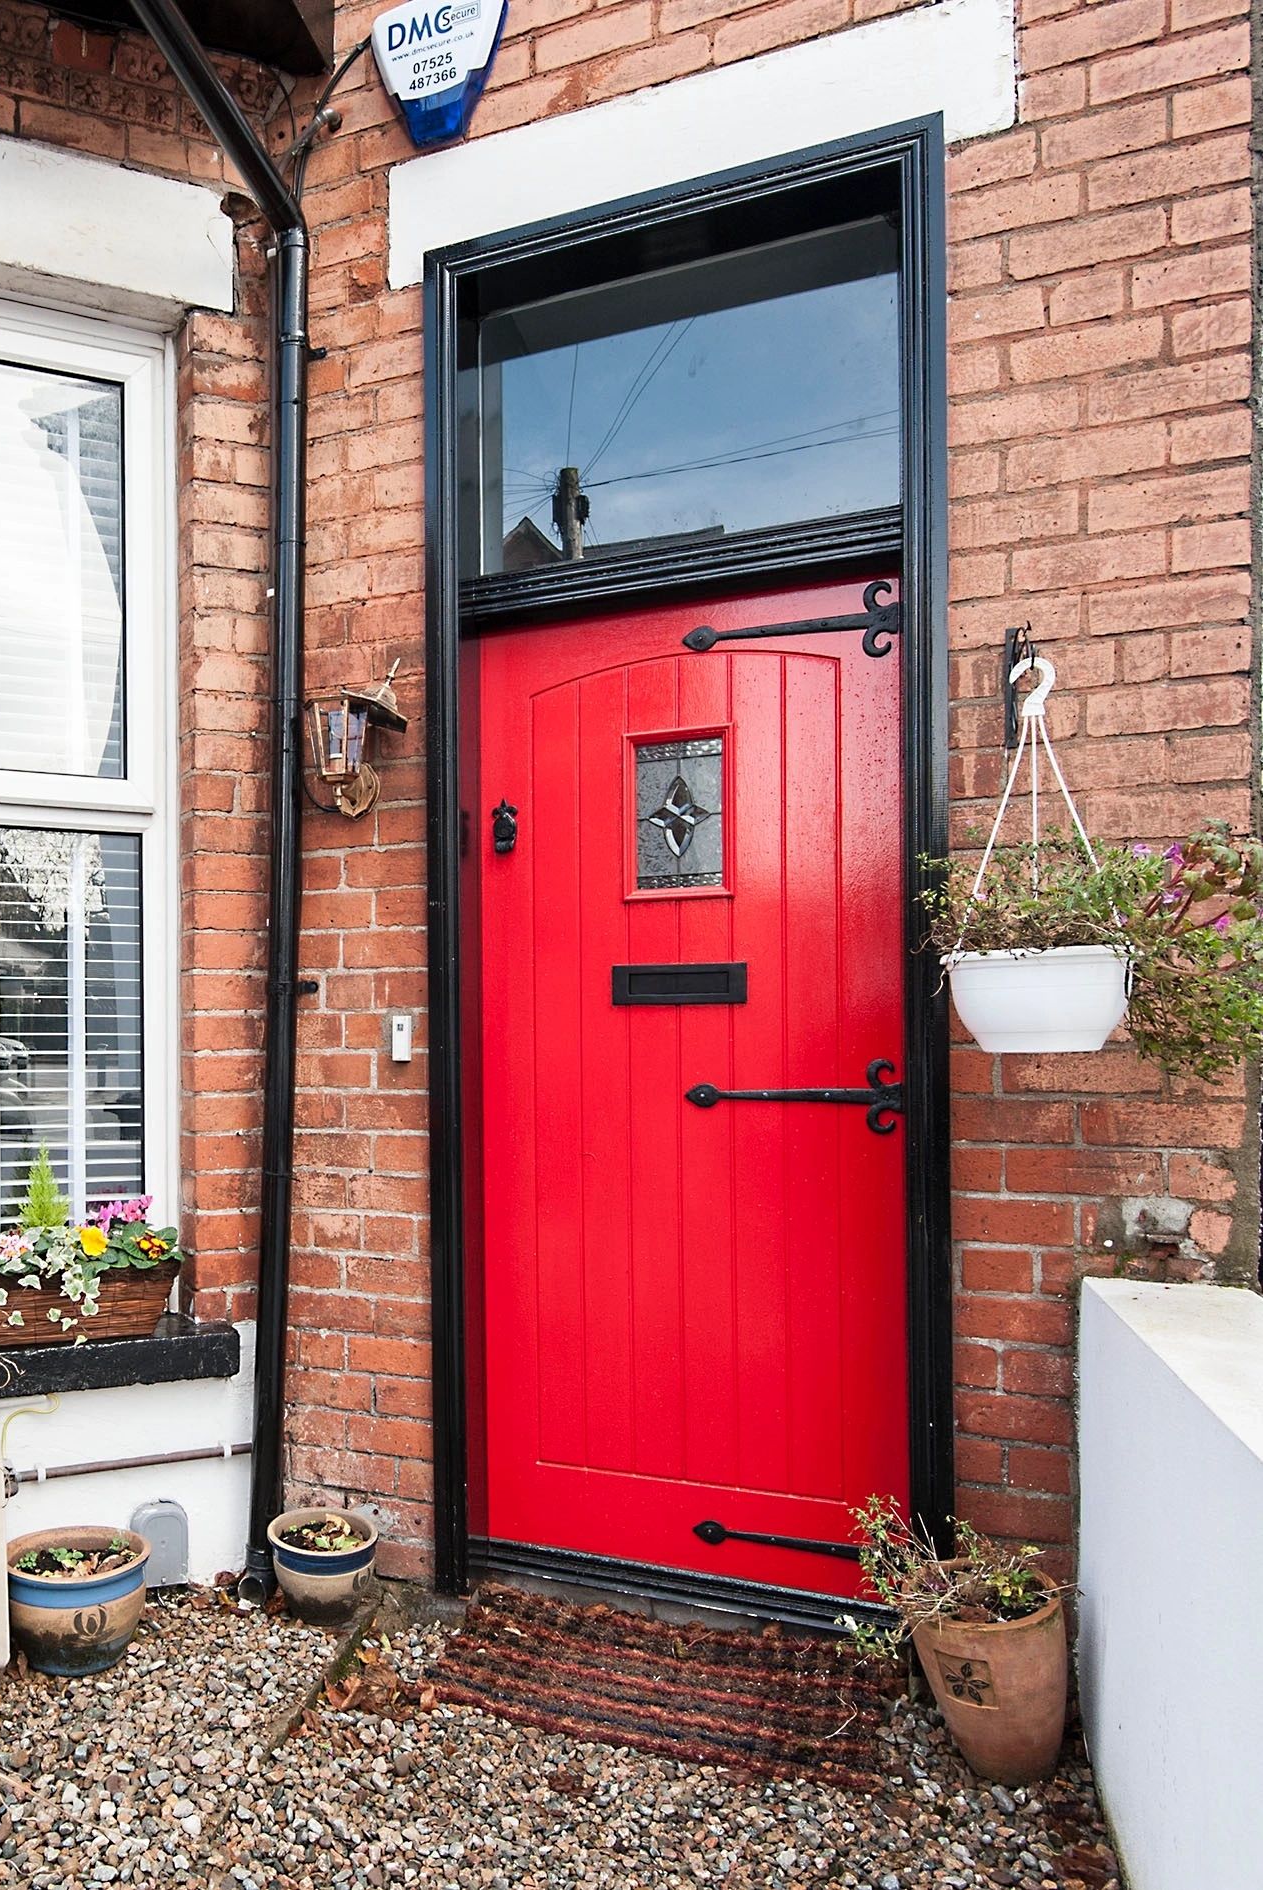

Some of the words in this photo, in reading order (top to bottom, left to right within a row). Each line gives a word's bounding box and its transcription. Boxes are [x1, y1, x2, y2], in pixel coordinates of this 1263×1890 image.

[388, 5, 453, 51] DMC
[442, 7, 476, 27] Secure
[391, 31, 475, 62] www.dmcsecure.co.uk
[413, 52, 453, 74] 07525
[409, 67, 457, 91] 487366
